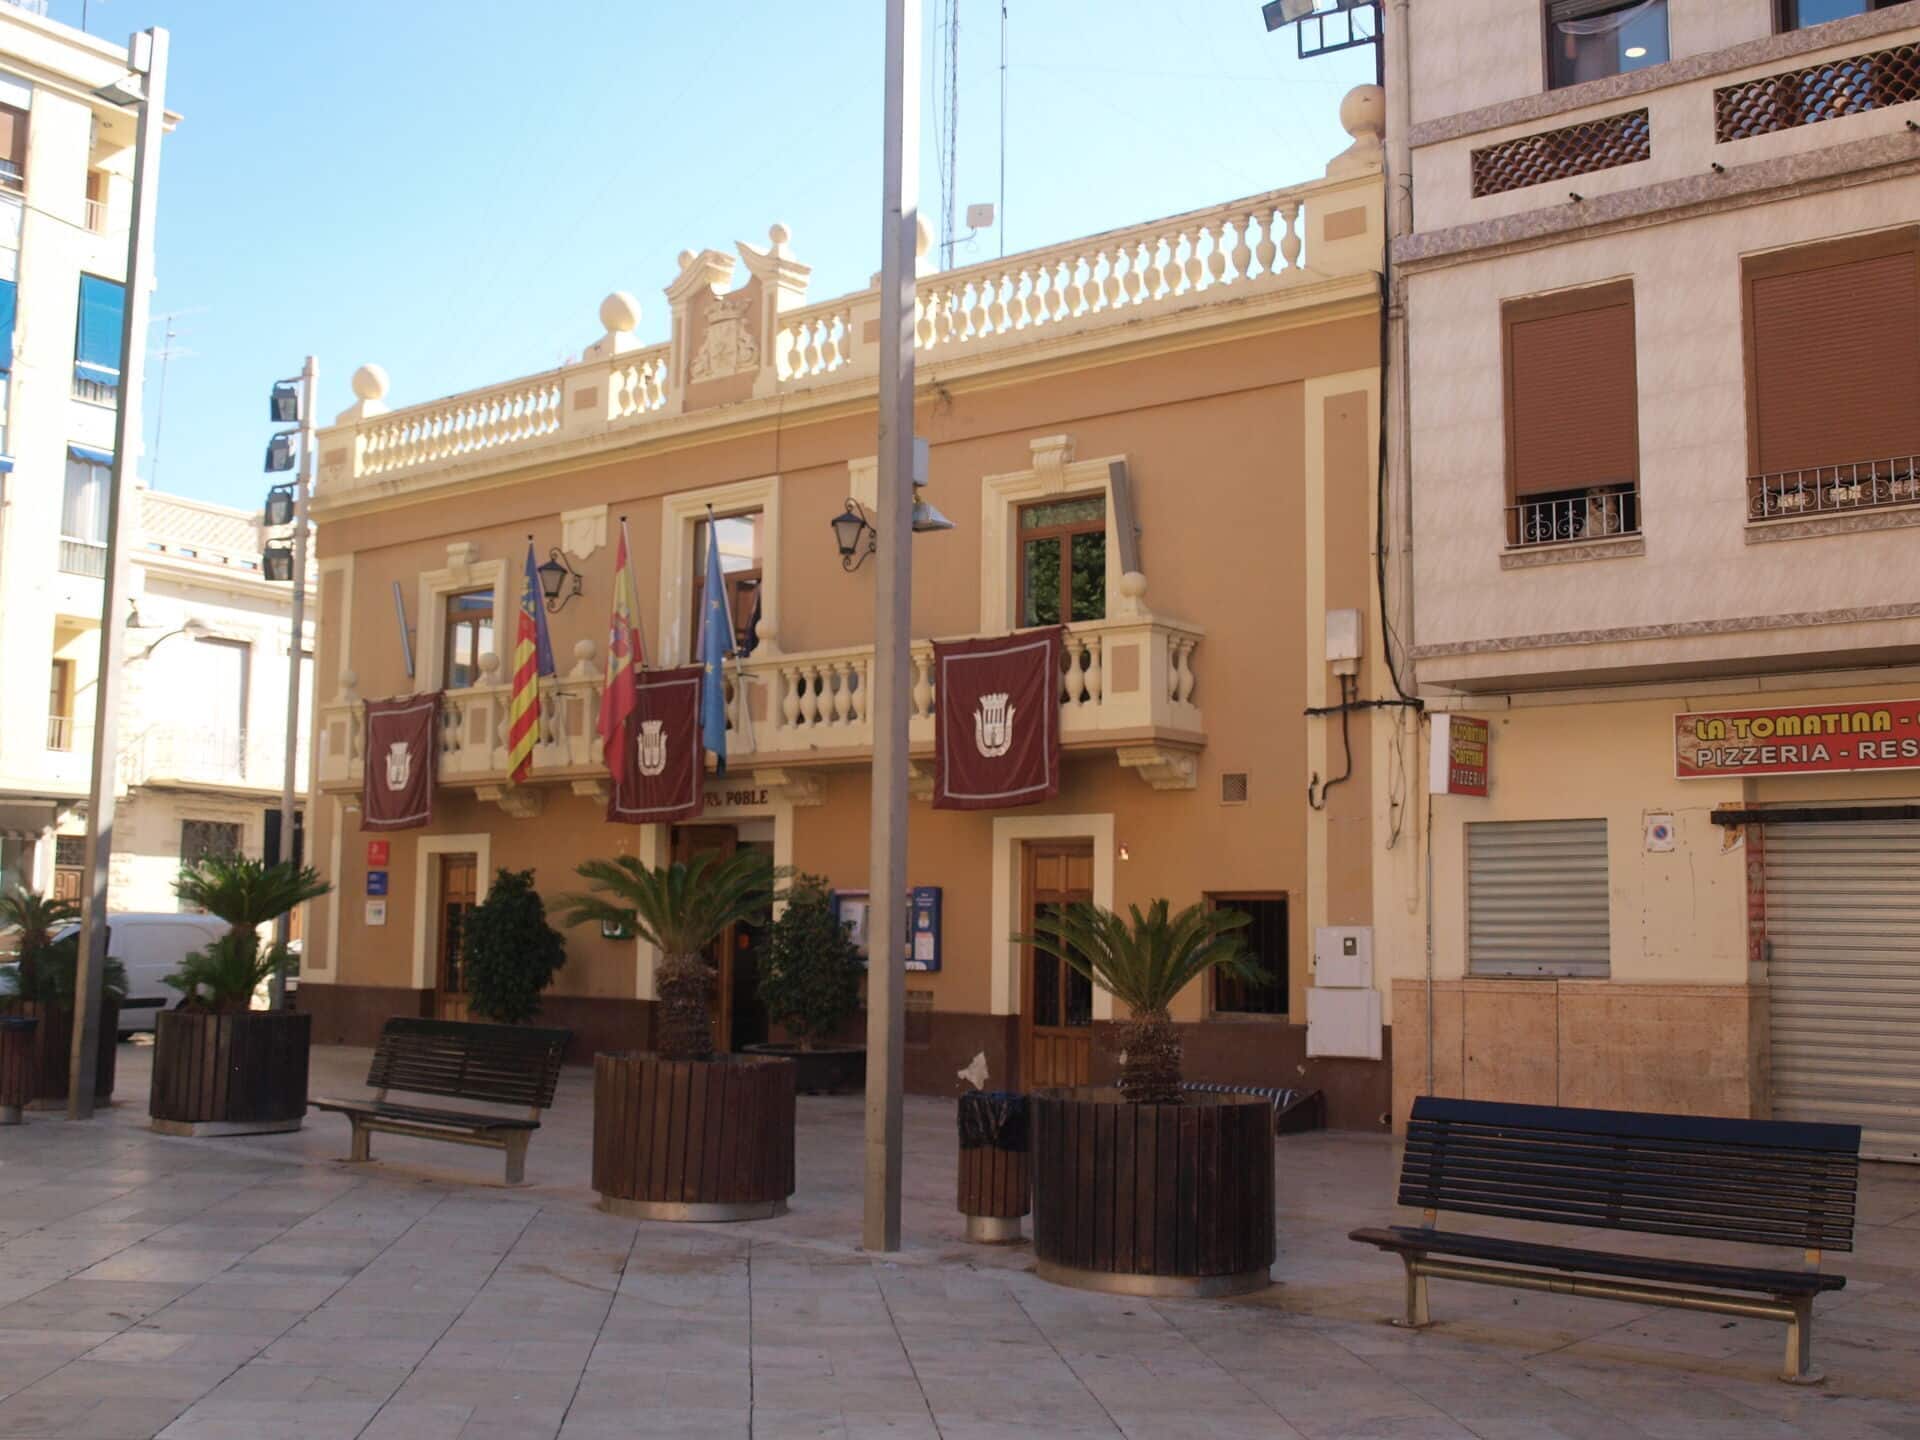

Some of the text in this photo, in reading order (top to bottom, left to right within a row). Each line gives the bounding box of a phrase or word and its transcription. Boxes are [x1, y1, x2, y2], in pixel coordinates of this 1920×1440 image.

[1696, 719, 1725, 741] LA
[1733, 711, 1891, 738] TOMATINA
[1696, 744, 1831, 768] PIZZERIA
[1452, 768, 1486, 786] PIZZERIA
[725, 790, 769, 806] POBLE
